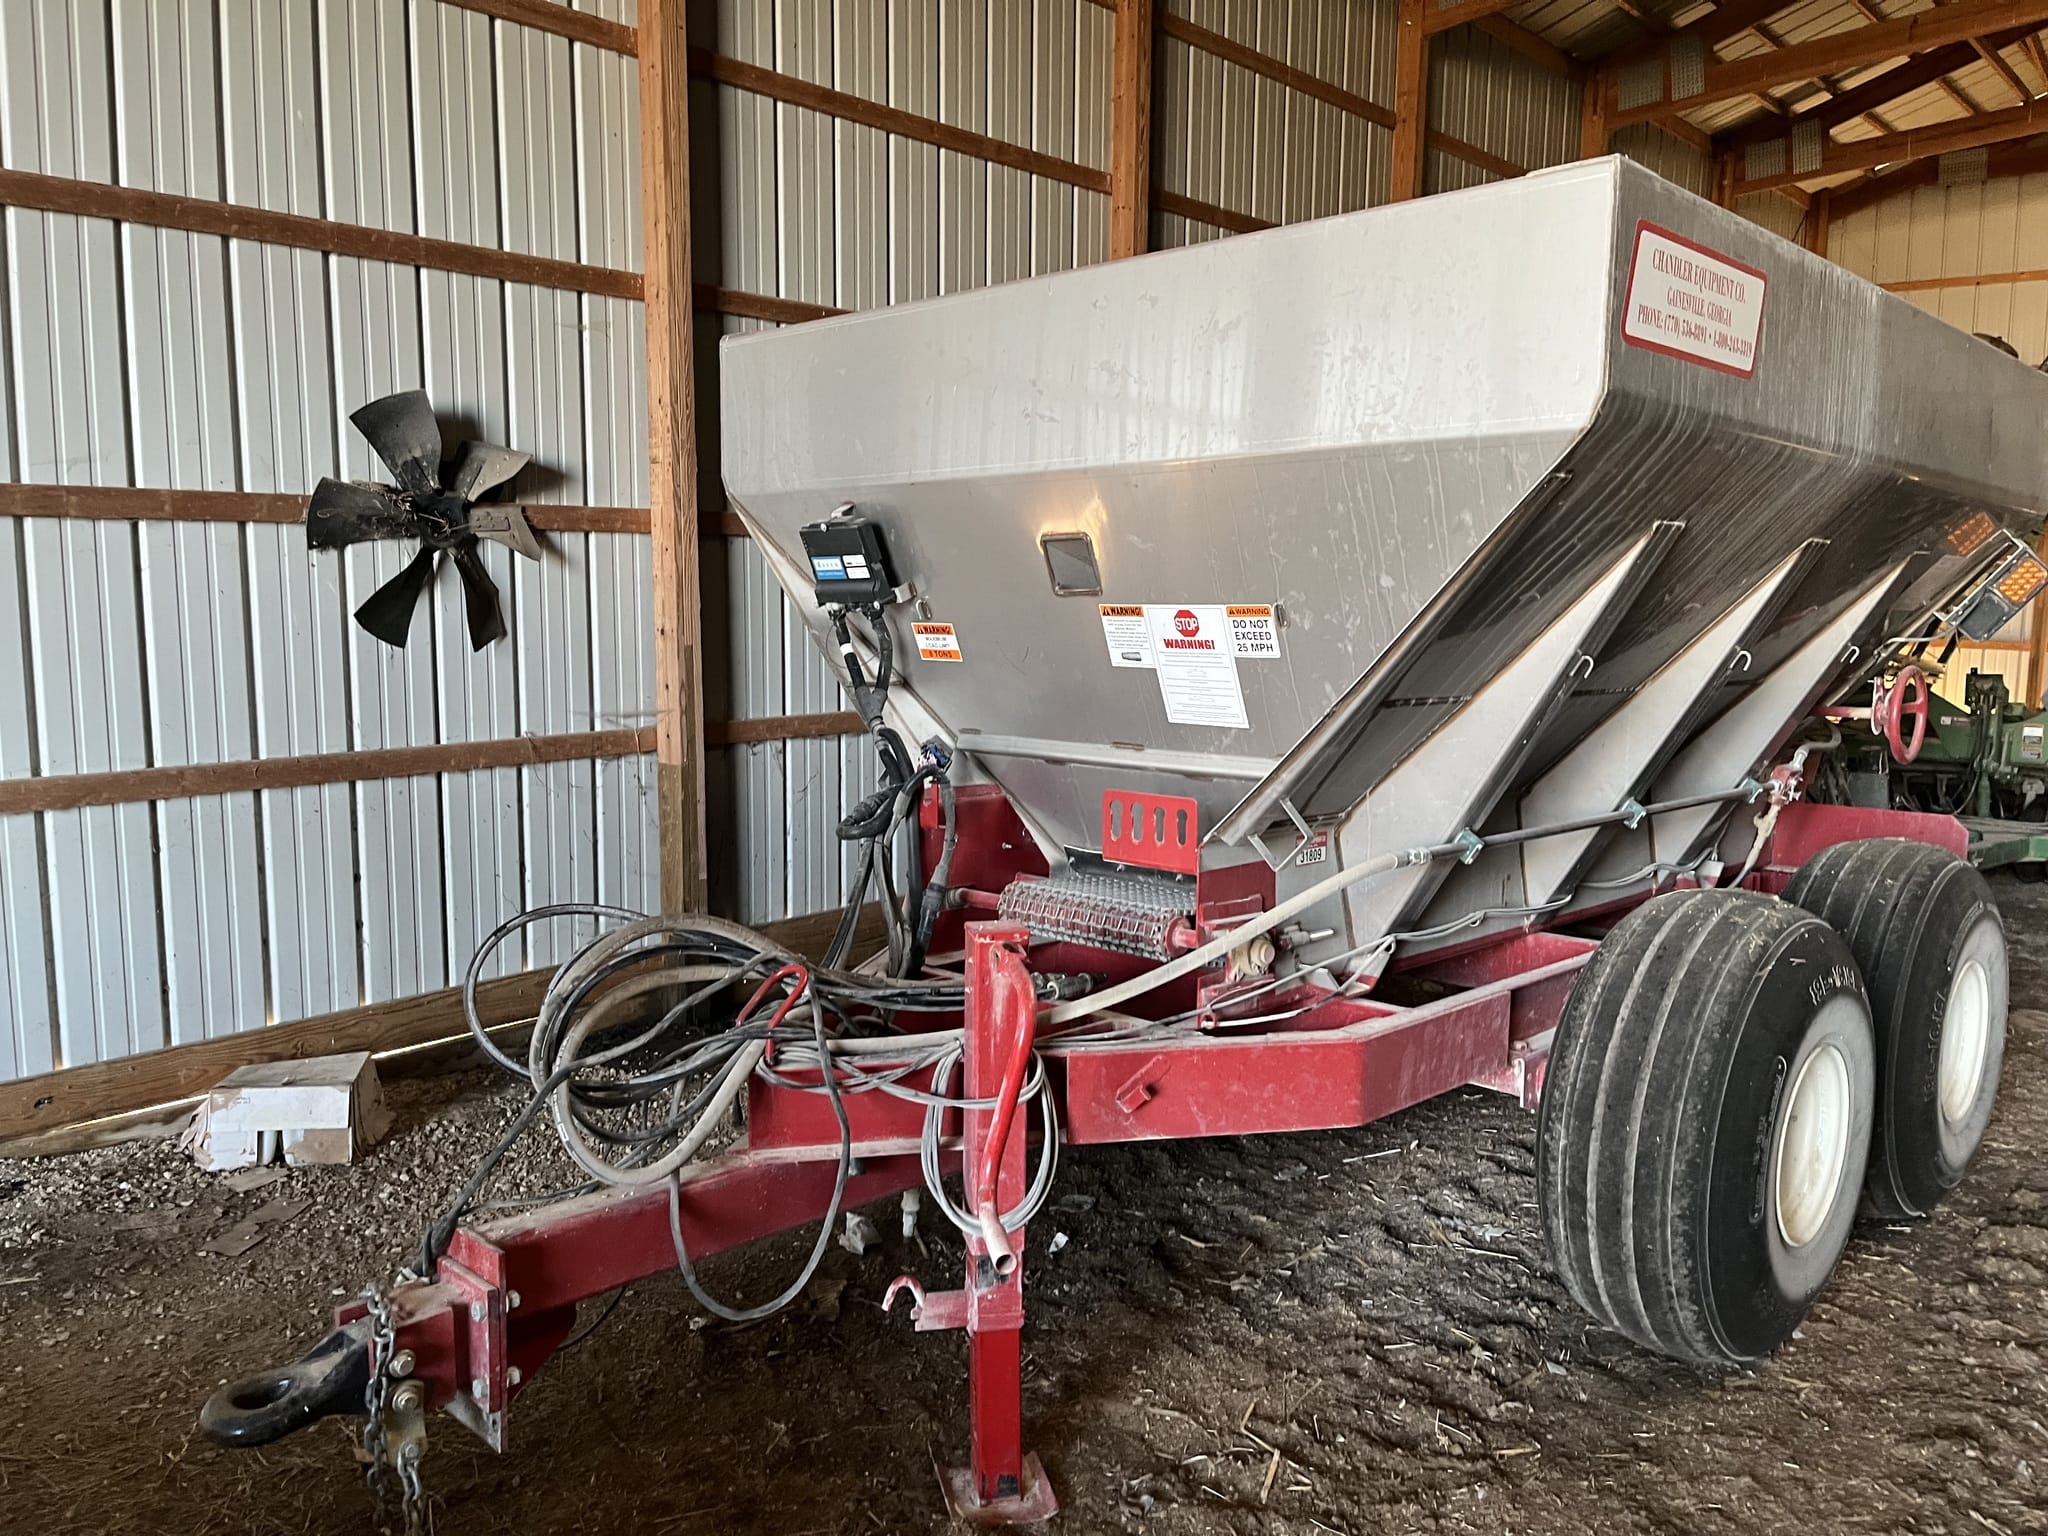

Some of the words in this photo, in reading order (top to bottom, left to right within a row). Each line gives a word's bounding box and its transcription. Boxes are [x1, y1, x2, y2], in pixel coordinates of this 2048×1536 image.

[1653, 248, 1693, 283] CHANDLER
[1694, 264, 1735, 300] EQUIPMENT
[1735, 281, 1746, 304] CO.
[1667, 286, 1705, 318] GAINESVILLE,
[1707, 301, 1732, 327] GEORGIA
[1638, 303, 1663, 329] PHONE:
[1664, 313, 1680, 340] (770)
[1237, 607, 1270, 615] WARNING
[1174, 618, 1198, 631] STOP
[1232, 619, 1247, 629] DO
[1249, 619, 1269, 629] NOT
[1234, 631, 1272, 641] EXCEED
[1163, 638, 1216, 650] WARNING!
[1237, 642, 1249, 652] 25
[1250, 642, 1274, 652] MPH
